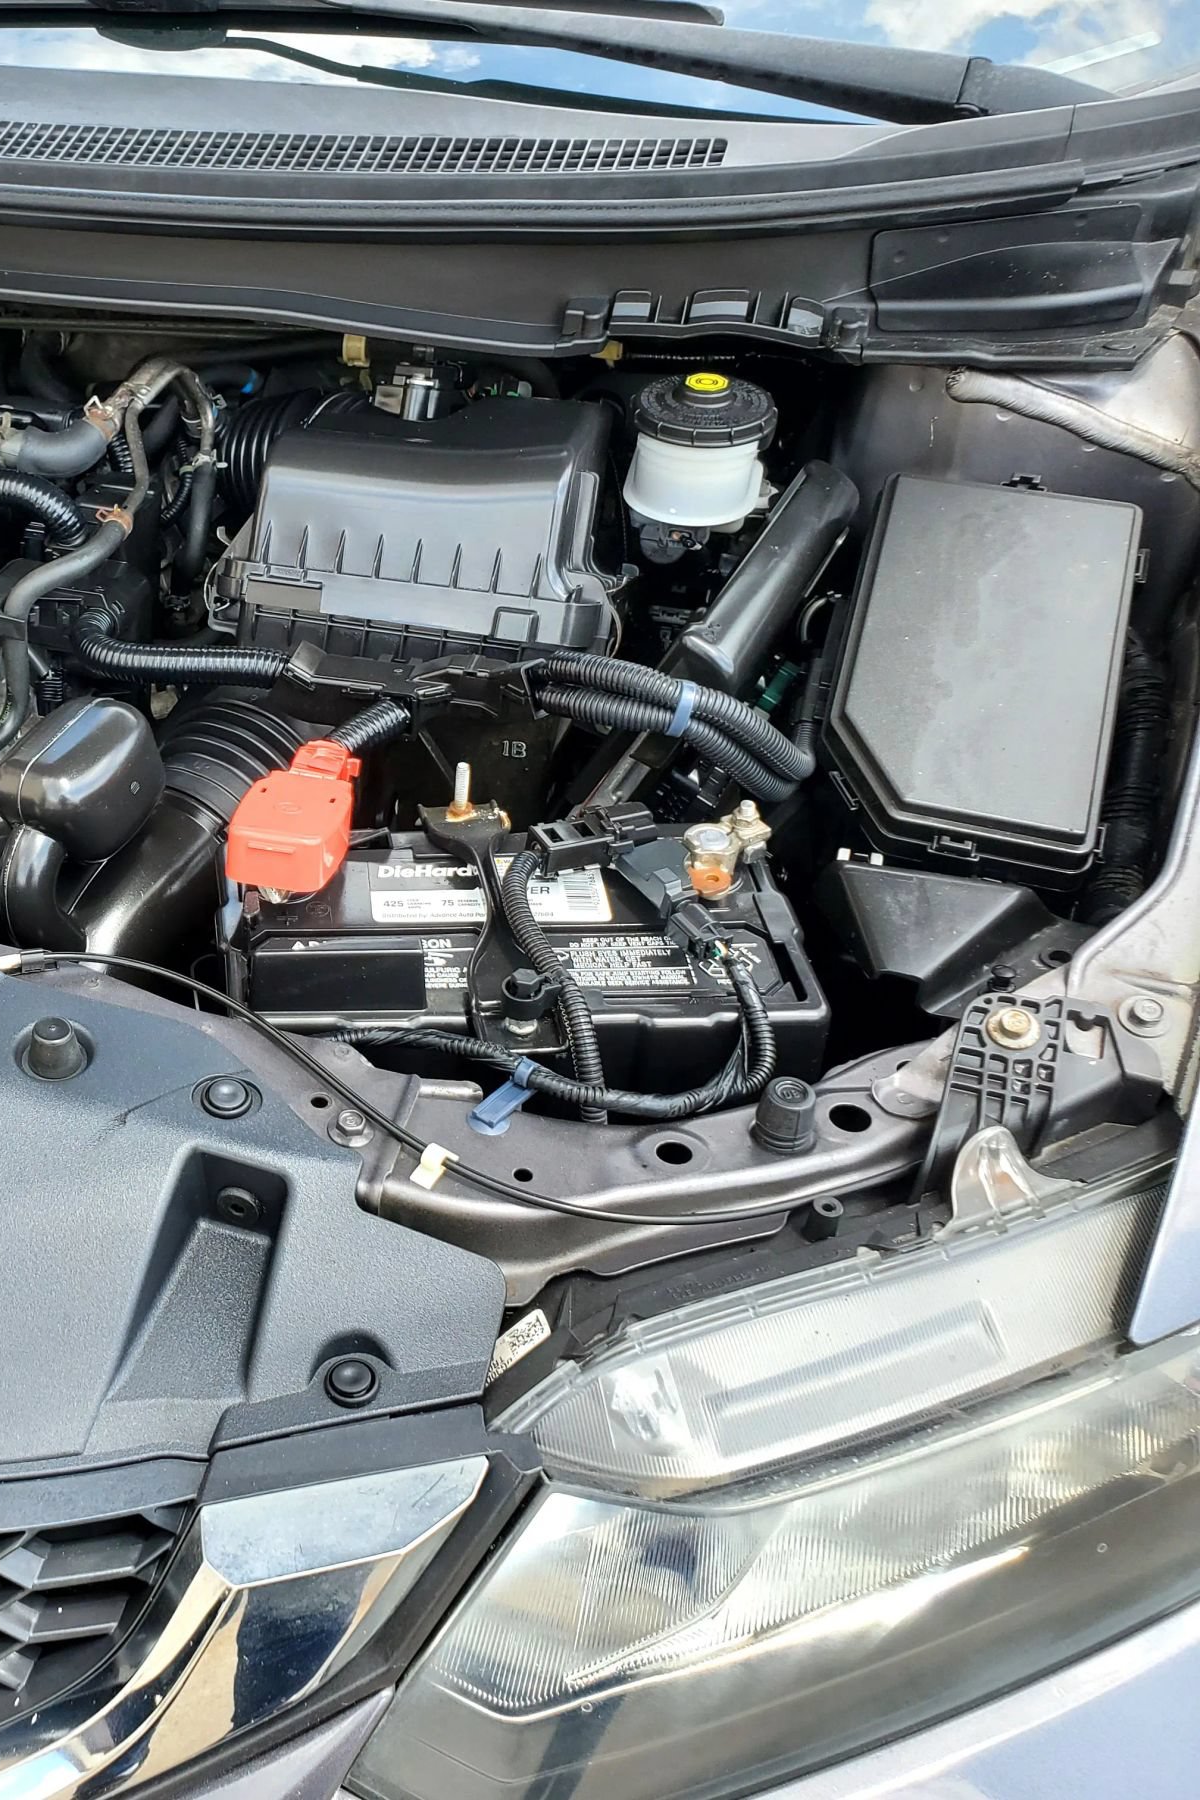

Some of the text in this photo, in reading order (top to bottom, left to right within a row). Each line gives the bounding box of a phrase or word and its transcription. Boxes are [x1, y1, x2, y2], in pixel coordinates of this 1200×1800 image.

[502, 740, 527, 758] 1B
[377, 863, 474, 879] DieHard
[527, 886, 550, 895] ER
[383, 899, 404, 907] 425
[441, 899, 455, 907] 75
